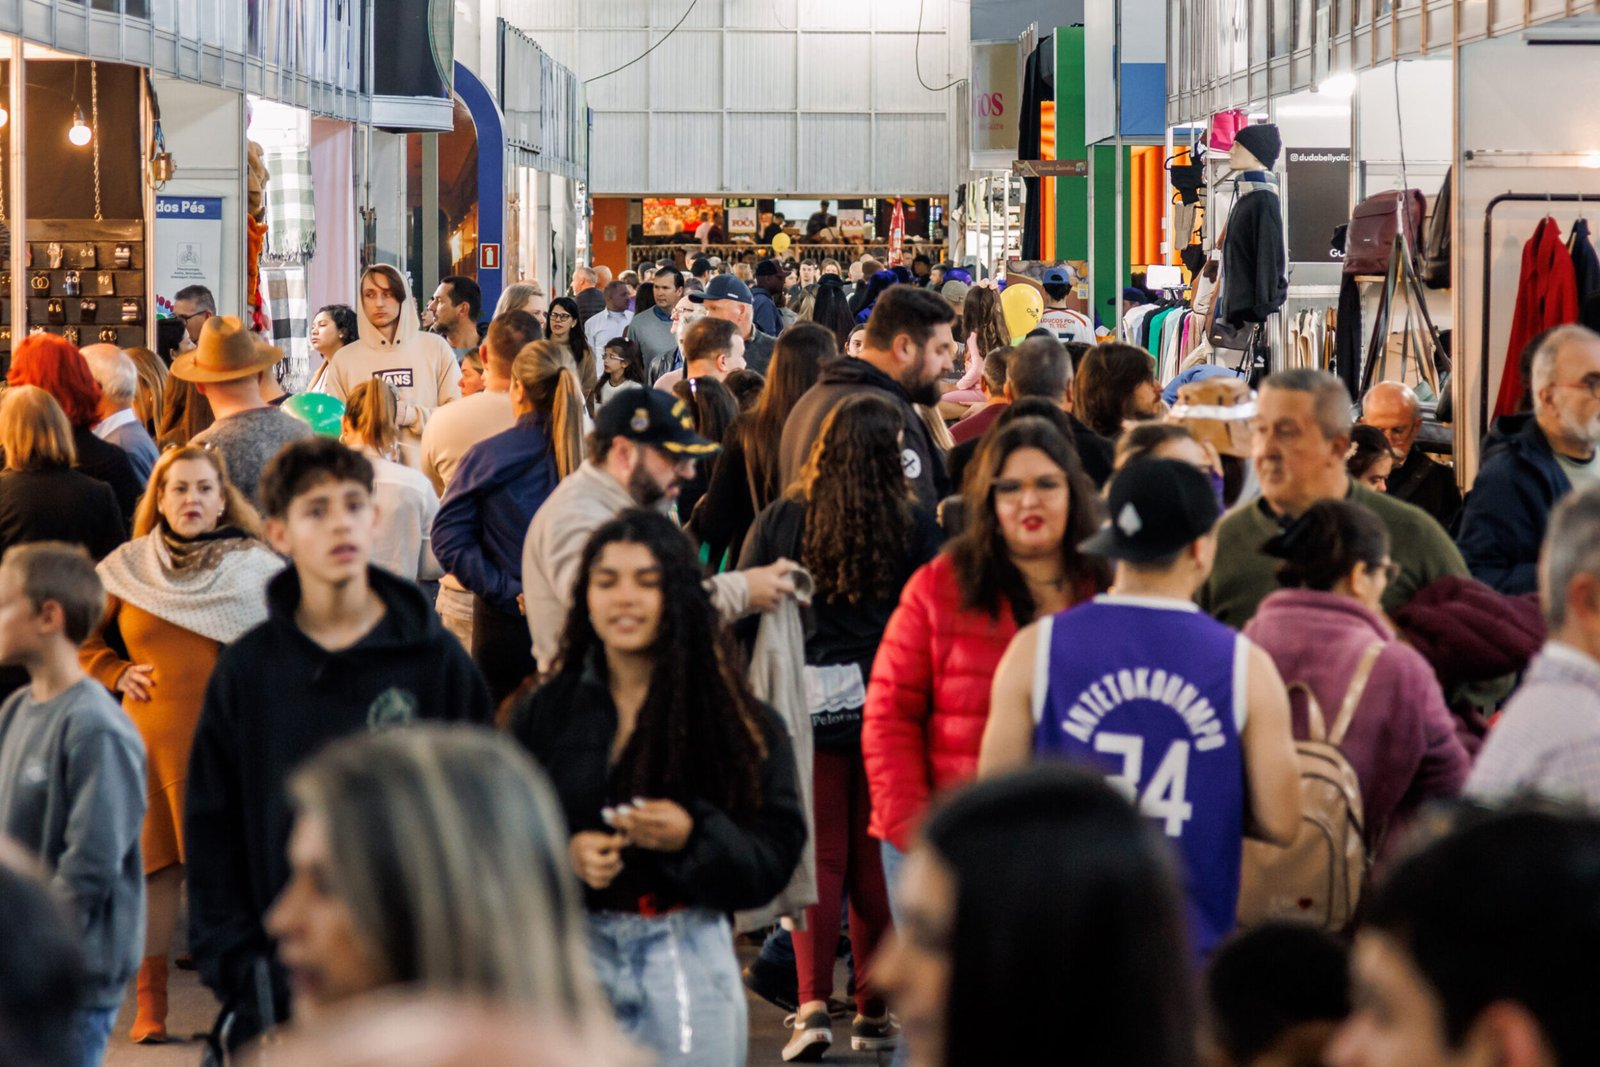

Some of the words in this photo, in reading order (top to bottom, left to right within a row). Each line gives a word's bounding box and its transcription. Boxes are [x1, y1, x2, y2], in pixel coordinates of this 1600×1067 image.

[156, 200, 179, 213] dos
[181, 200, 205, 213] Pés
[1094, 731, 1193, 837] 34
